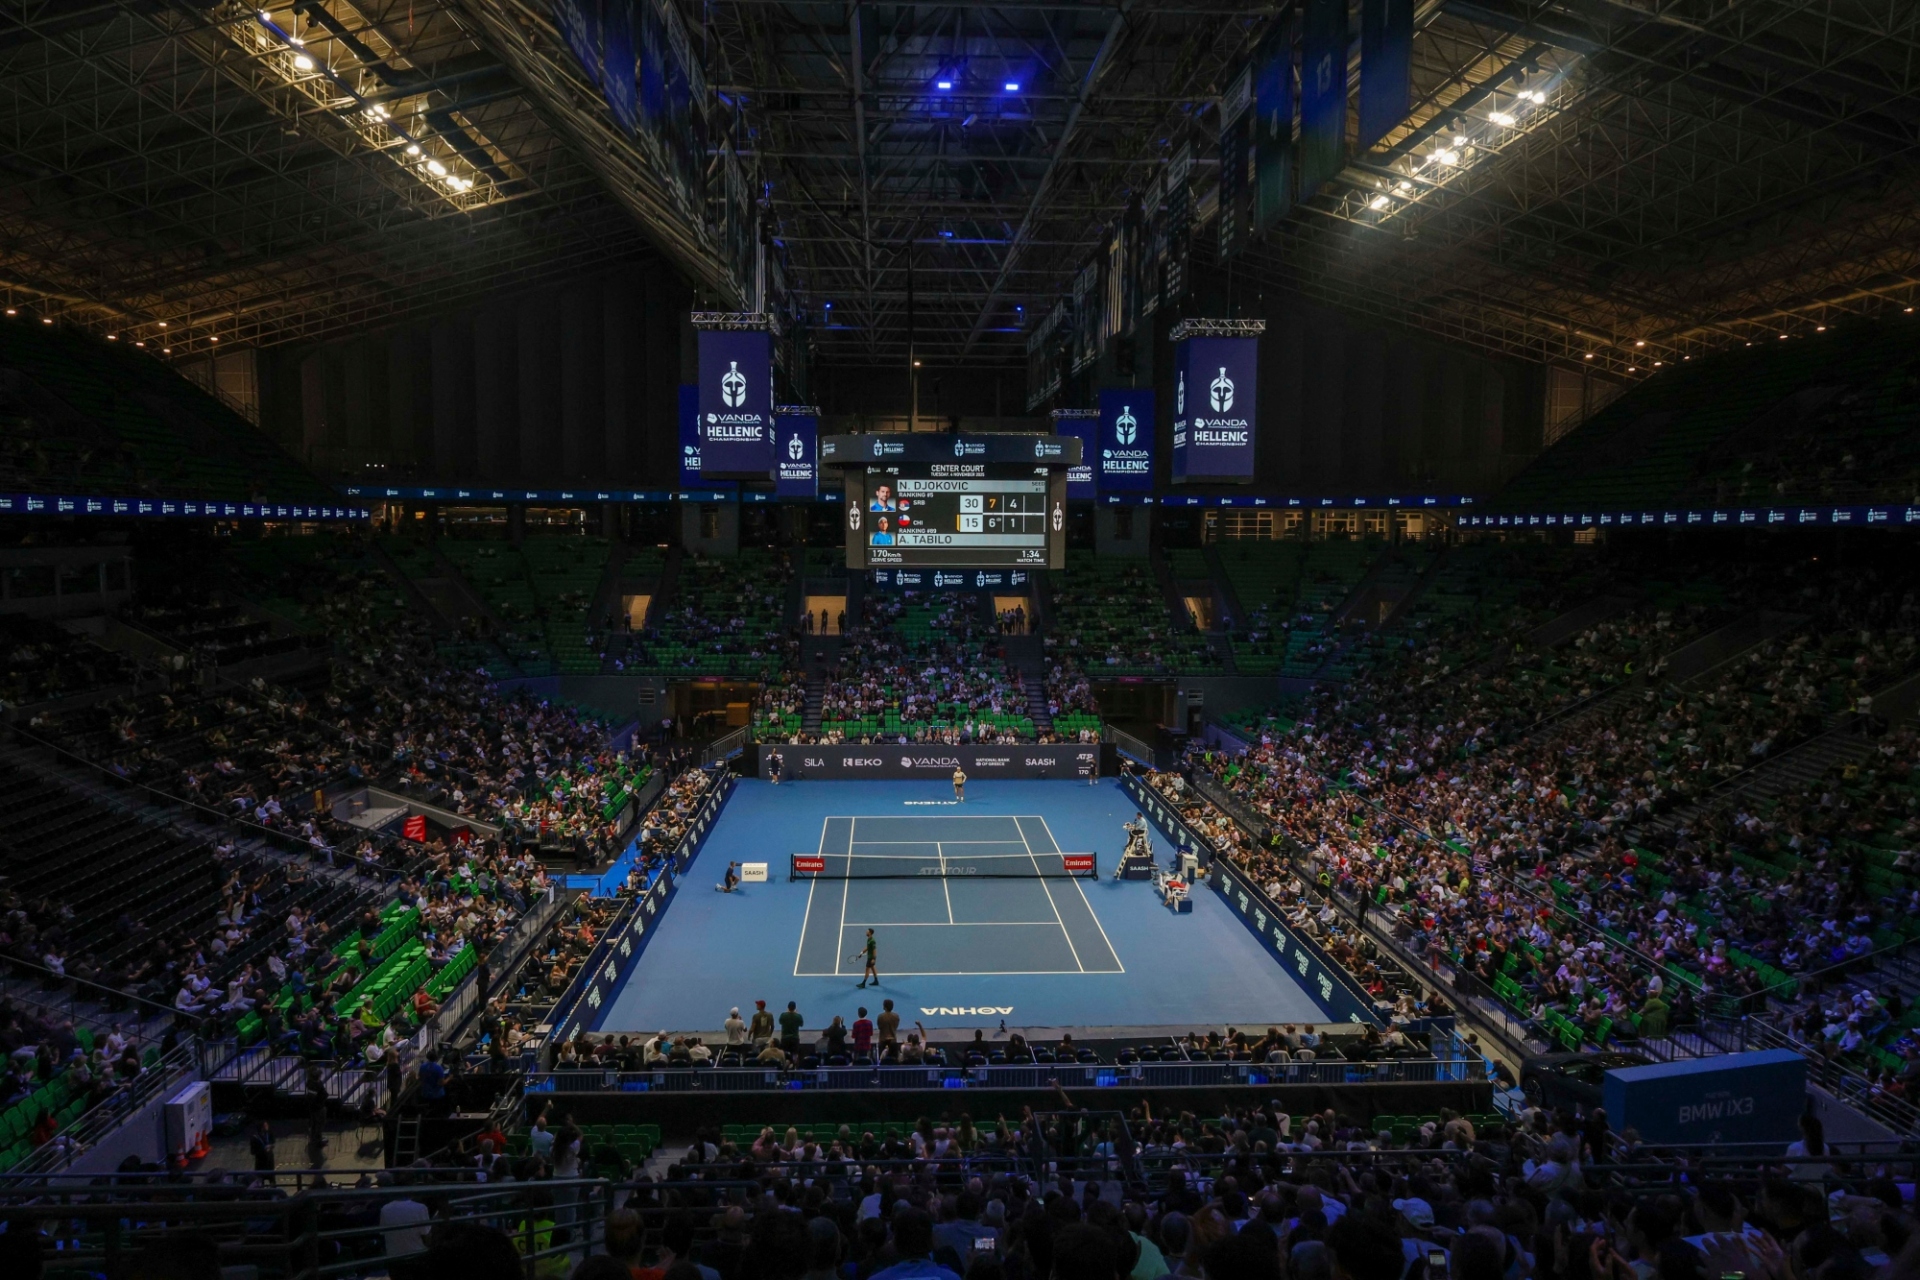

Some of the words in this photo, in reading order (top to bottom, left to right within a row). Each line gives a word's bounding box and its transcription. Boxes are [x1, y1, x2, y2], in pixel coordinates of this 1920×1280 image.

[707, 426, 762, 437] HELLENIC
[1194, 430, 1248, 442] HELLENIC
[1102, 460, 1149, 470] HELLENIC
[899, 482, 910, 490] N.
[914, 482, 968, 490] DJOKOVIC
[964, 498, 978, 508] 30
[989, 498, 996, 508] 7
[1010, 498, 1017, 508] 4
[966, 518, 978, 528] 15
[988, 518, 996, 528] 6
[1010, 518, 1015, 528] 1
[899, 536, 910, 544] A.
[912, 536, 952, 544] TABILO
[804, 758, 824, 766] SILA
[854, 758, 882, 766] EKO
[1026, 758, 1056, 766] SAASH
[946, 866, 976, 875] TOUR
[1678, 1101, 1724, 1124] BMW
